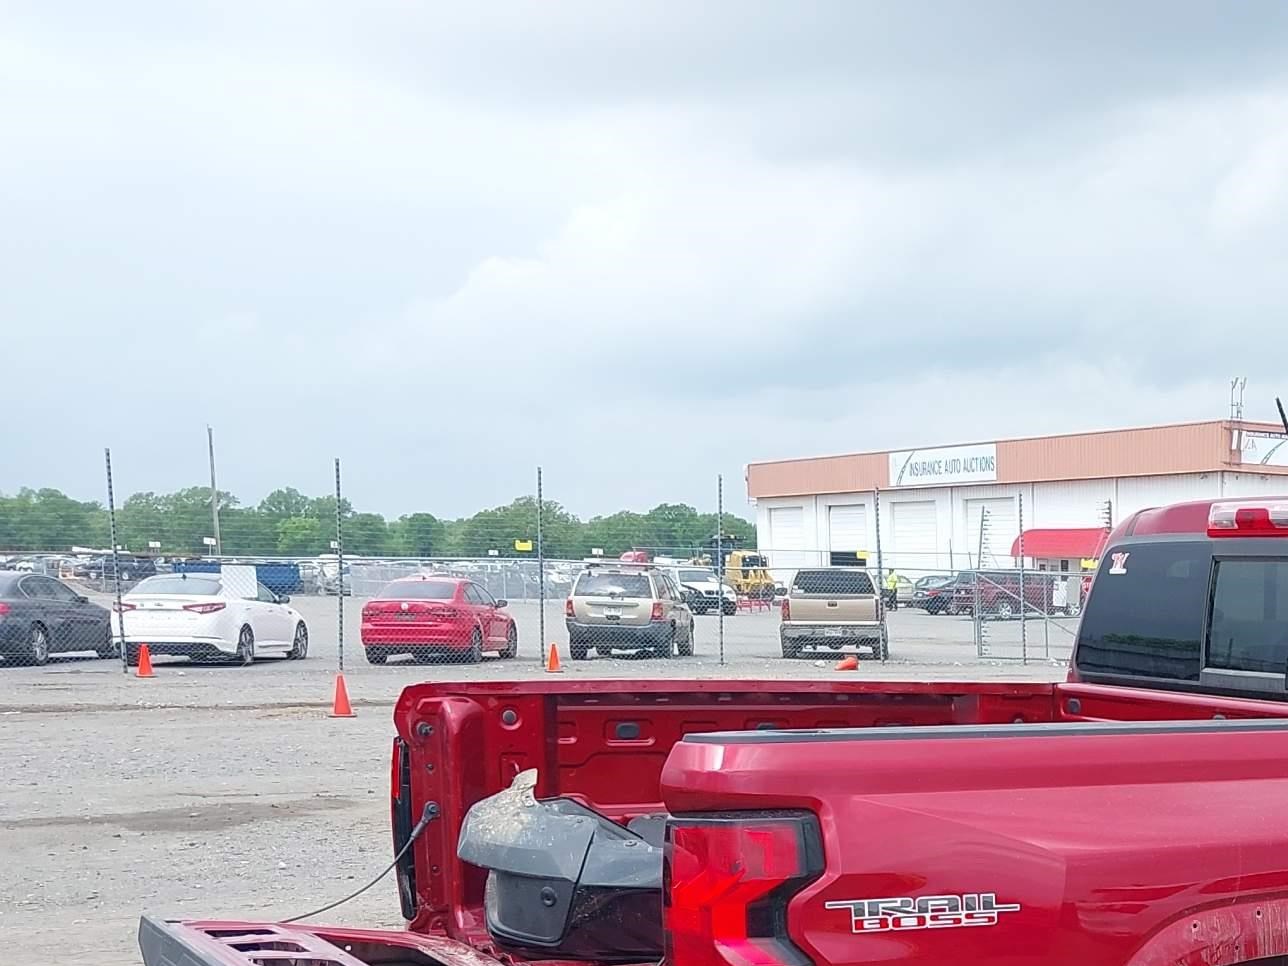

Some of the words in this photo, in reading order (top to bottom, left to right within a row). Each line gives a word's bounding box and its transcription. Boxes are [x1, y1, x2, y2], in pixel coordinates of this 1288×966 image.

[909, 459, 943, 477] INSURANCE
[944, 458, 961, 474] AUTO
[962, 455, 995, 473] AUCTIONS
[825, 893, 1021, 919] TRAIL
[851, 911, 998, 933] BOSS
